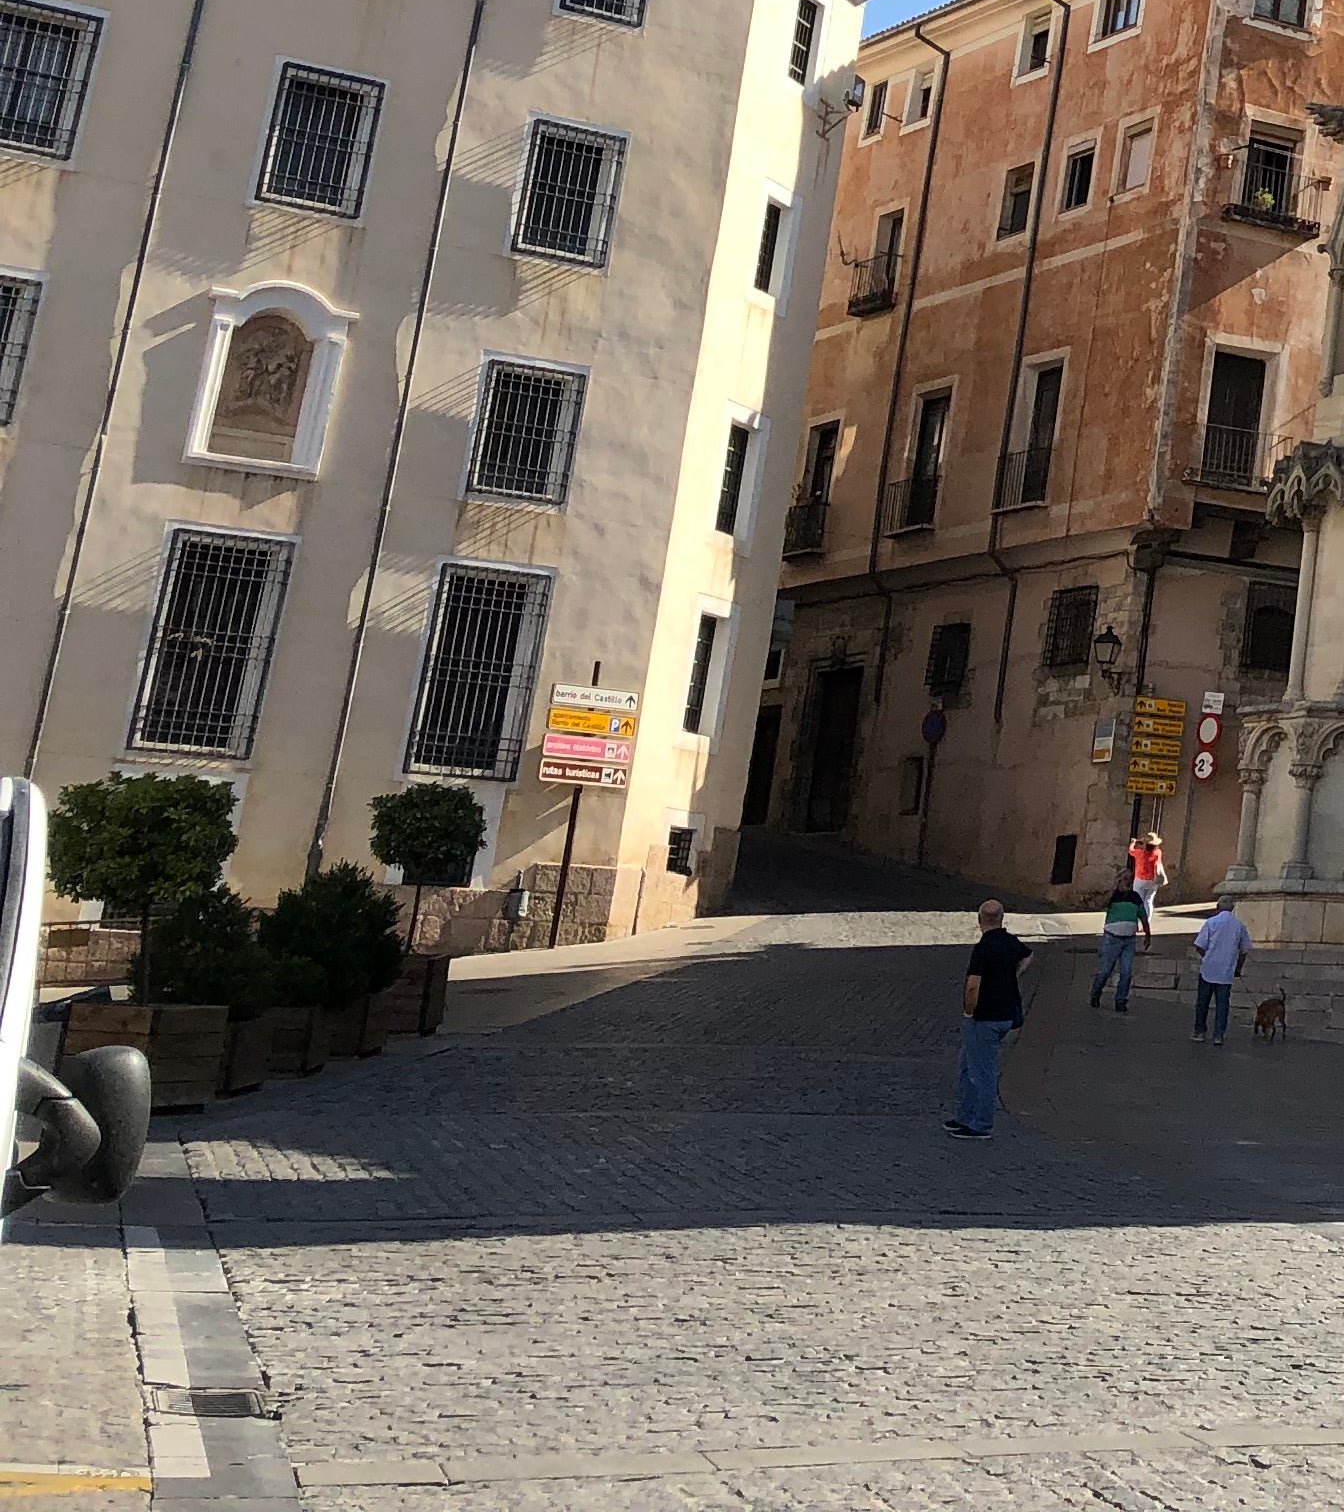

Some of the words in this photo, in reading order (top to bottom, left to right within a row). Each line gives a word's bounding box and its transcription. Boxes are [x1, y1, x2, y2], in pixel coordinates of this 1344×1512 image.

[556, 690, 577, 699] barrio
[580, 692, 591, 700] del
[594, 694, 622, 704] Castillo
[542, 766, 563, 776] rutas
[565, 767, 600, 779] turísticas
